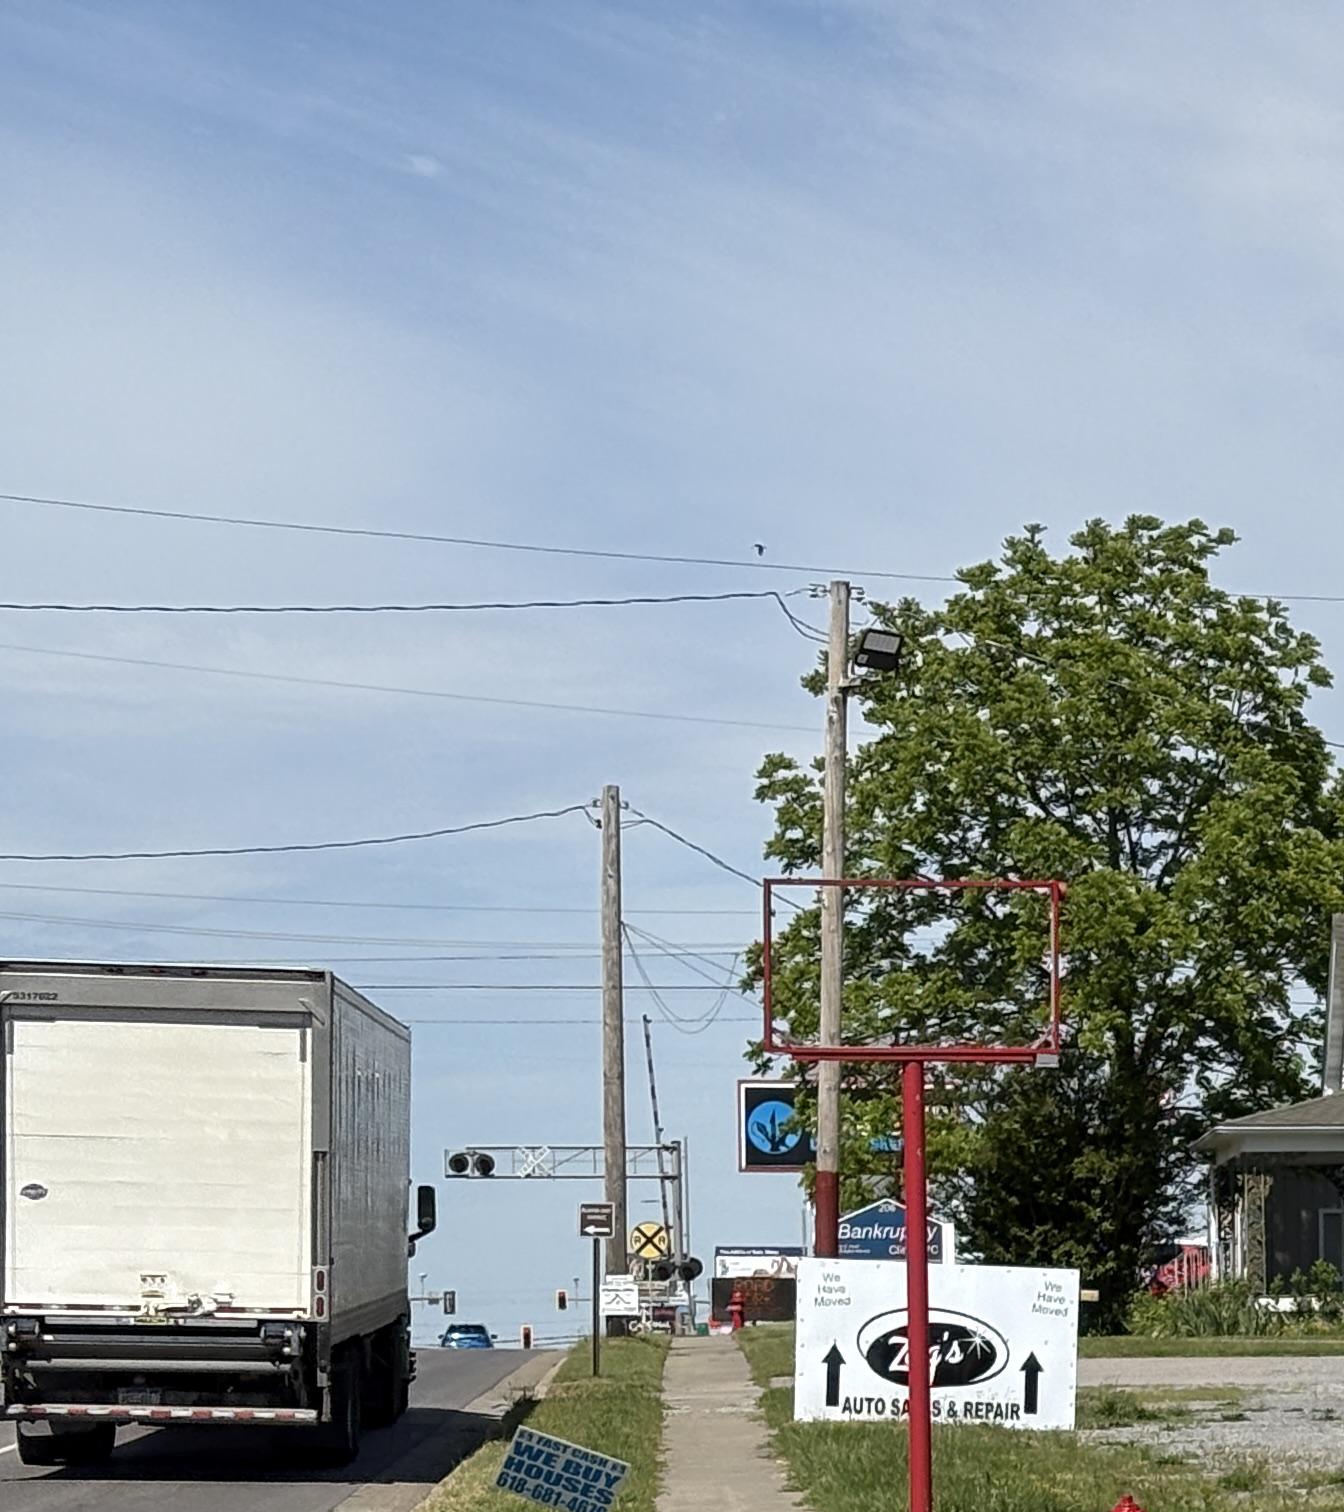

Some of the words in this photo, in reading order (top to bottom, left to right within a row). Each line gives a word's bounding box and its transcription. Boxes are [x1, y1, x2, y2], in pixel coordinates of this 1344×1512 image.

[822, 1272, 841, 1283] We
[1044, 1281, 1062, 1293] We
[814, 1296, 851, 1307] Moved
[1036, 1291, 1066, 1305] Have
[1032, 1302, 1068, 1317] Moved
[842, 1396, 886, 1415] AUTO
[890, 1398, 942, 1417] SAS
[946, 1400, 958, 1418] &
[963, 1402, 1021, 1420] REPAIR
[535, 1436, 572, 1454] FAST
[572, 1448, 609, 1468] CASH
[513, 1441, 560, 1469] WE
[561, 1458, 621, 1489] BUY
[503, 1454, 614, 1505] HOUSES
